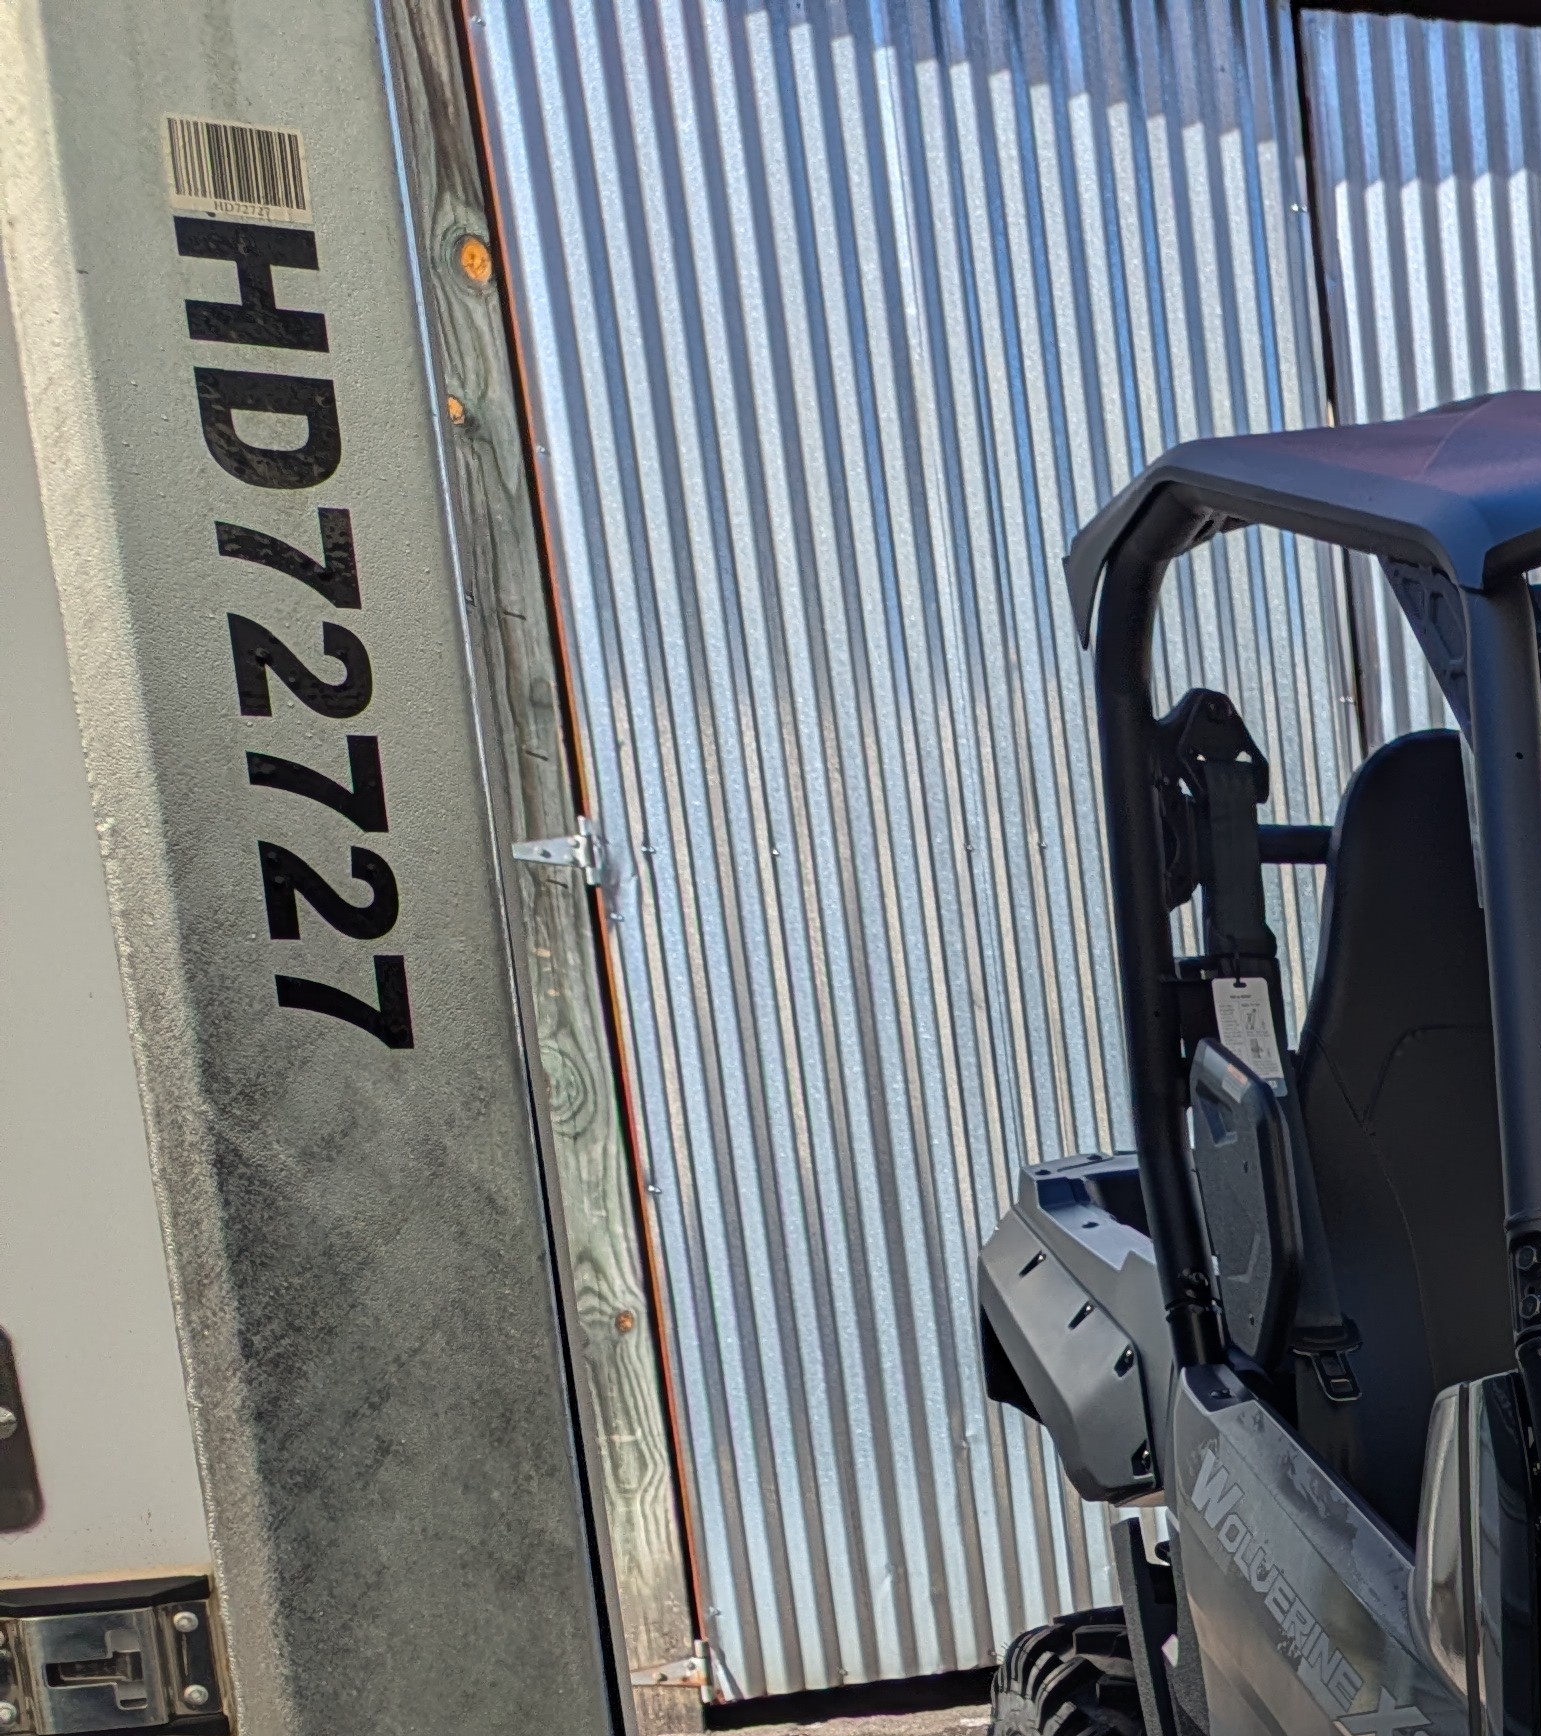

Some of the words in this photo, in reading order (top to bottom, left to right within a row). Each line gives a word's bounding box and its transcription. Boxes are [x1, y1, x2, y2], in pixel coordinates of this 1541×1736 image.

[214, 200, 271, 219] HD72727
[174, 216, 414, 1049] HD72727
[1191, 1448, 1364, 1713] WOLVERINE
